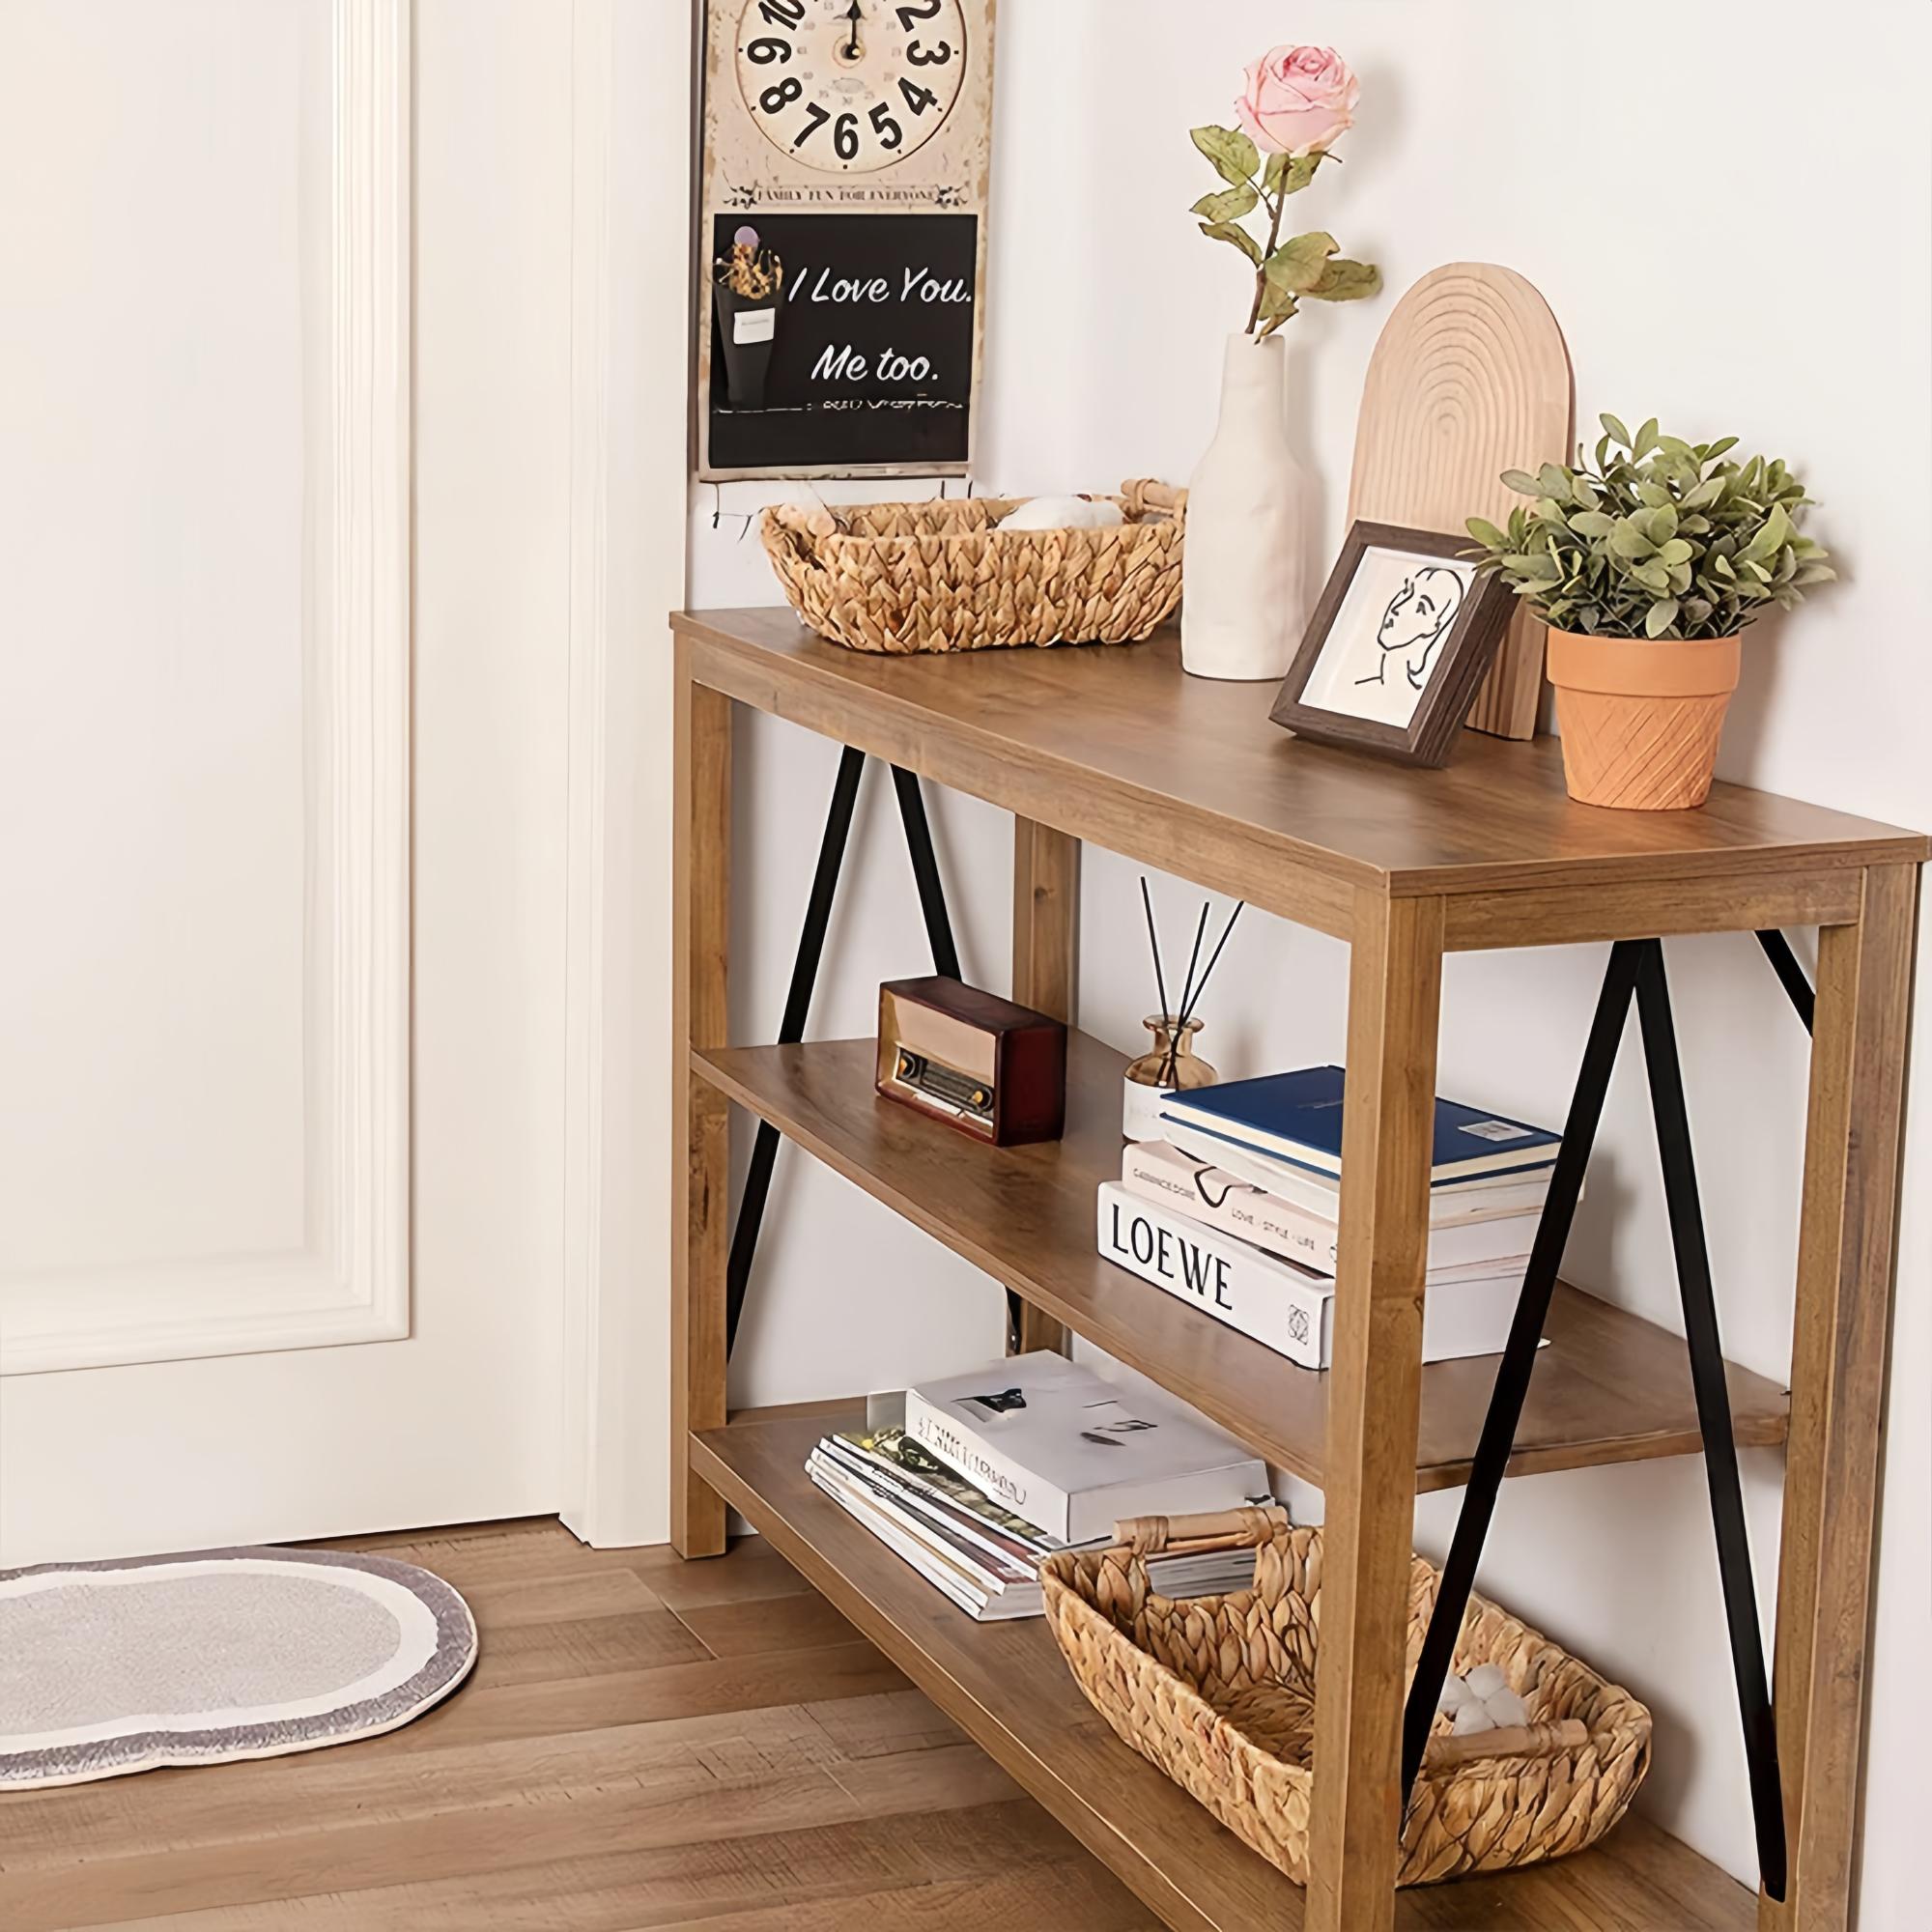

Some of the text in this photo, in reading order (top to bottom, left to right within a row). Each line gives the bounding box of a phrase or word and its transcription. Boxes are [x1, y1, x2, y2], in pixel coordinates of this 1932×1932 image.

[895, 0, 941, 32] 2
[747, 37, 792, 65] 9
[906, 40, 951, 67] 3
[759, 76, 803, 114] 8
[897, 76, 938, 116] 4
[793, 101, 831, 148] 7
[834, 112, 859, 160] 6
[868, 101, 902, 150] 5
[788, 267, 972, 302] I Love You.
[810, 344, 938, 381] Me too.
[1112, 1203, 1233, 1311] LOEWE
